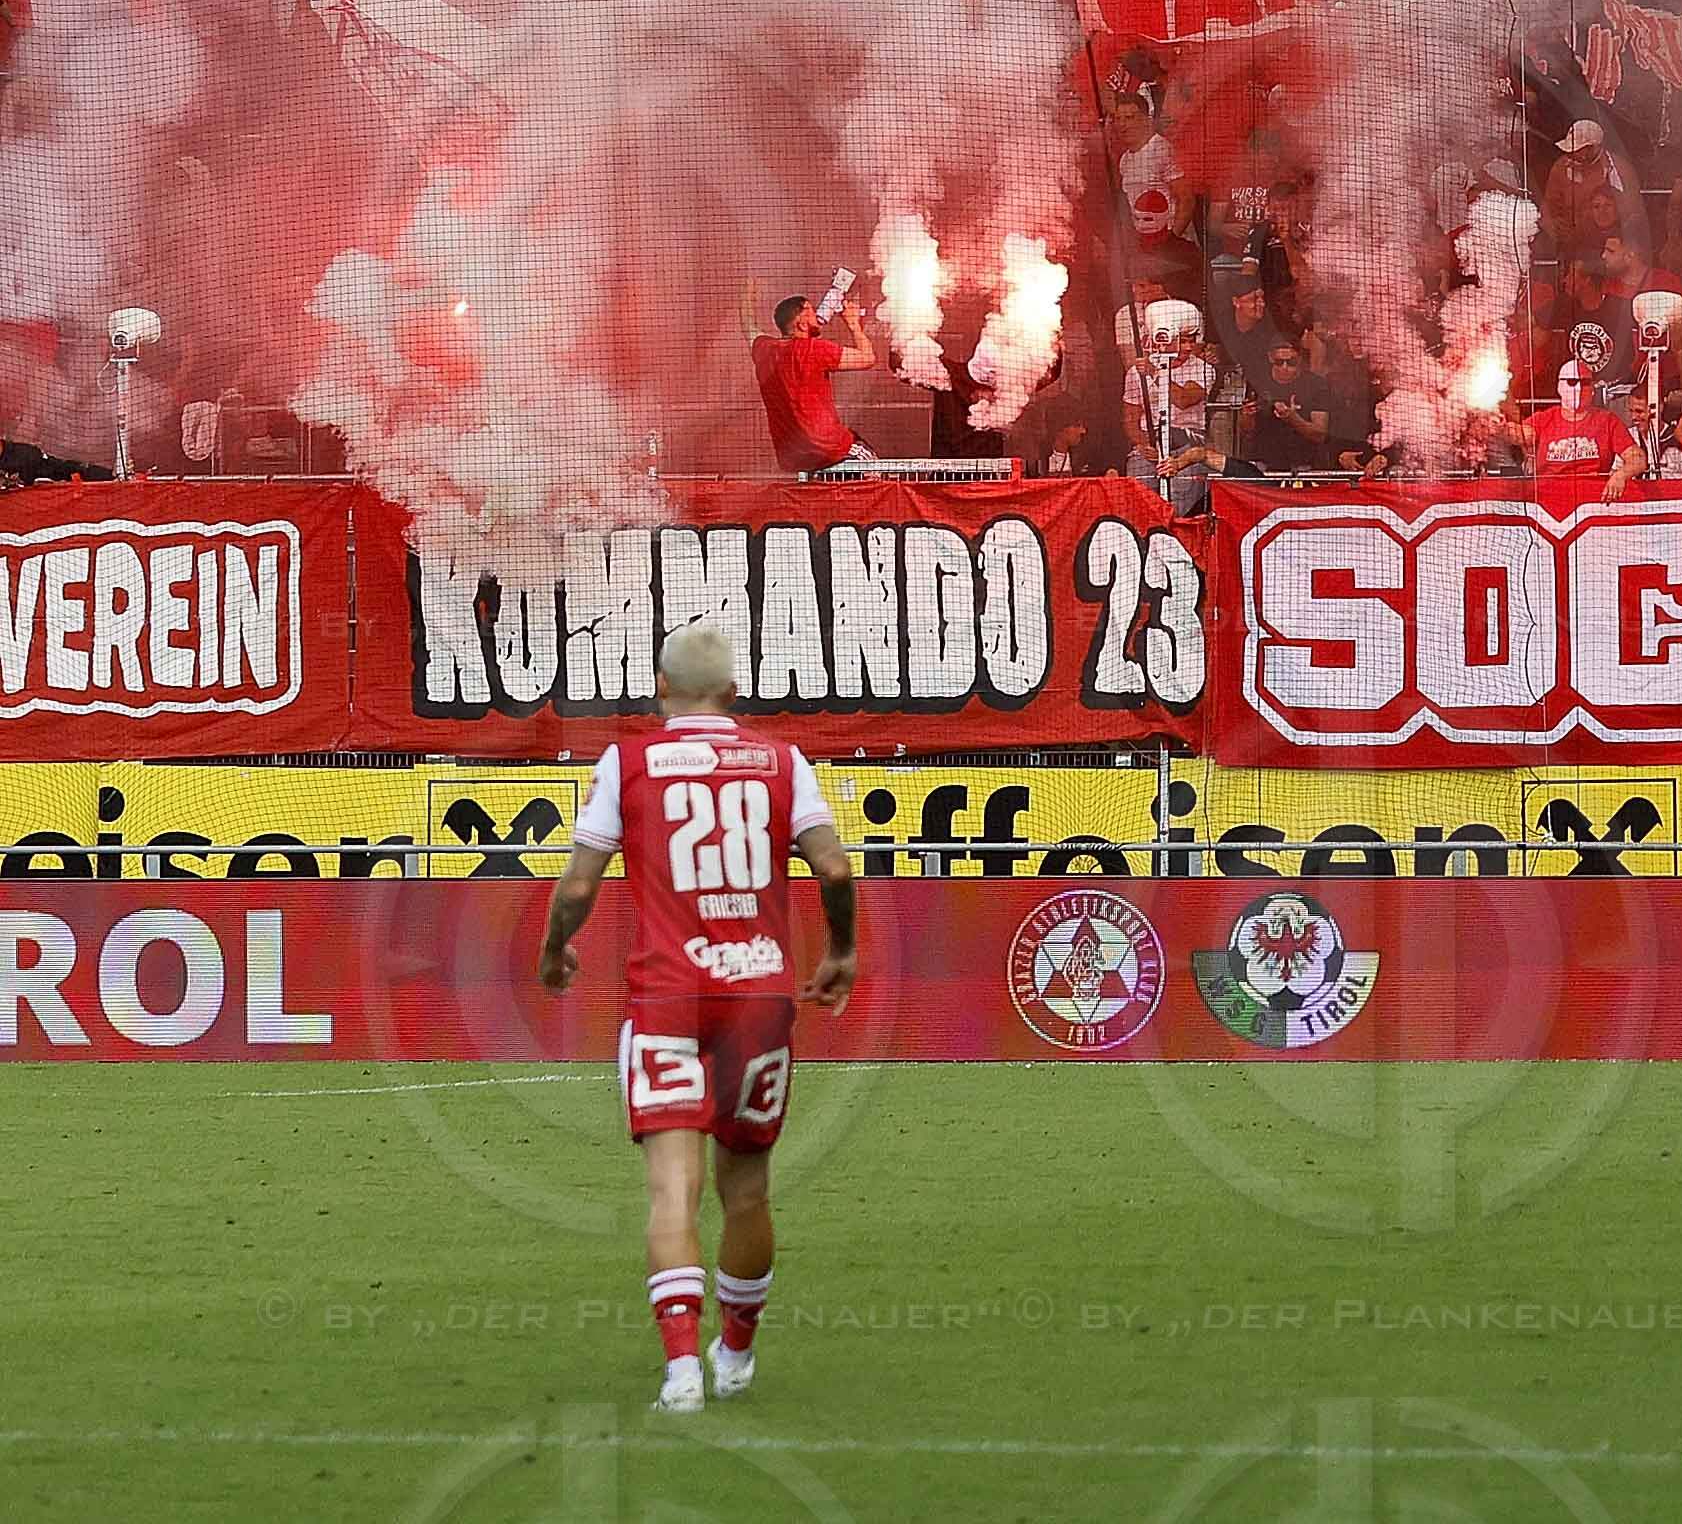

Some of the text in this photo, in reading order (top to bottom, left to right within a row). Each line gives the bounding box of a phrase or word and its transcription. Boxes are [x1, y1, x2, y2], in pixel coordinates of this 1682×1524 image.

[0, 542, 278, 693] VEREIN
[412, 518, 1206, 712] KOMMANDO 23
[663, 780, 773, 892] 28
[1300, 975, 1369, 1037] TIROL
